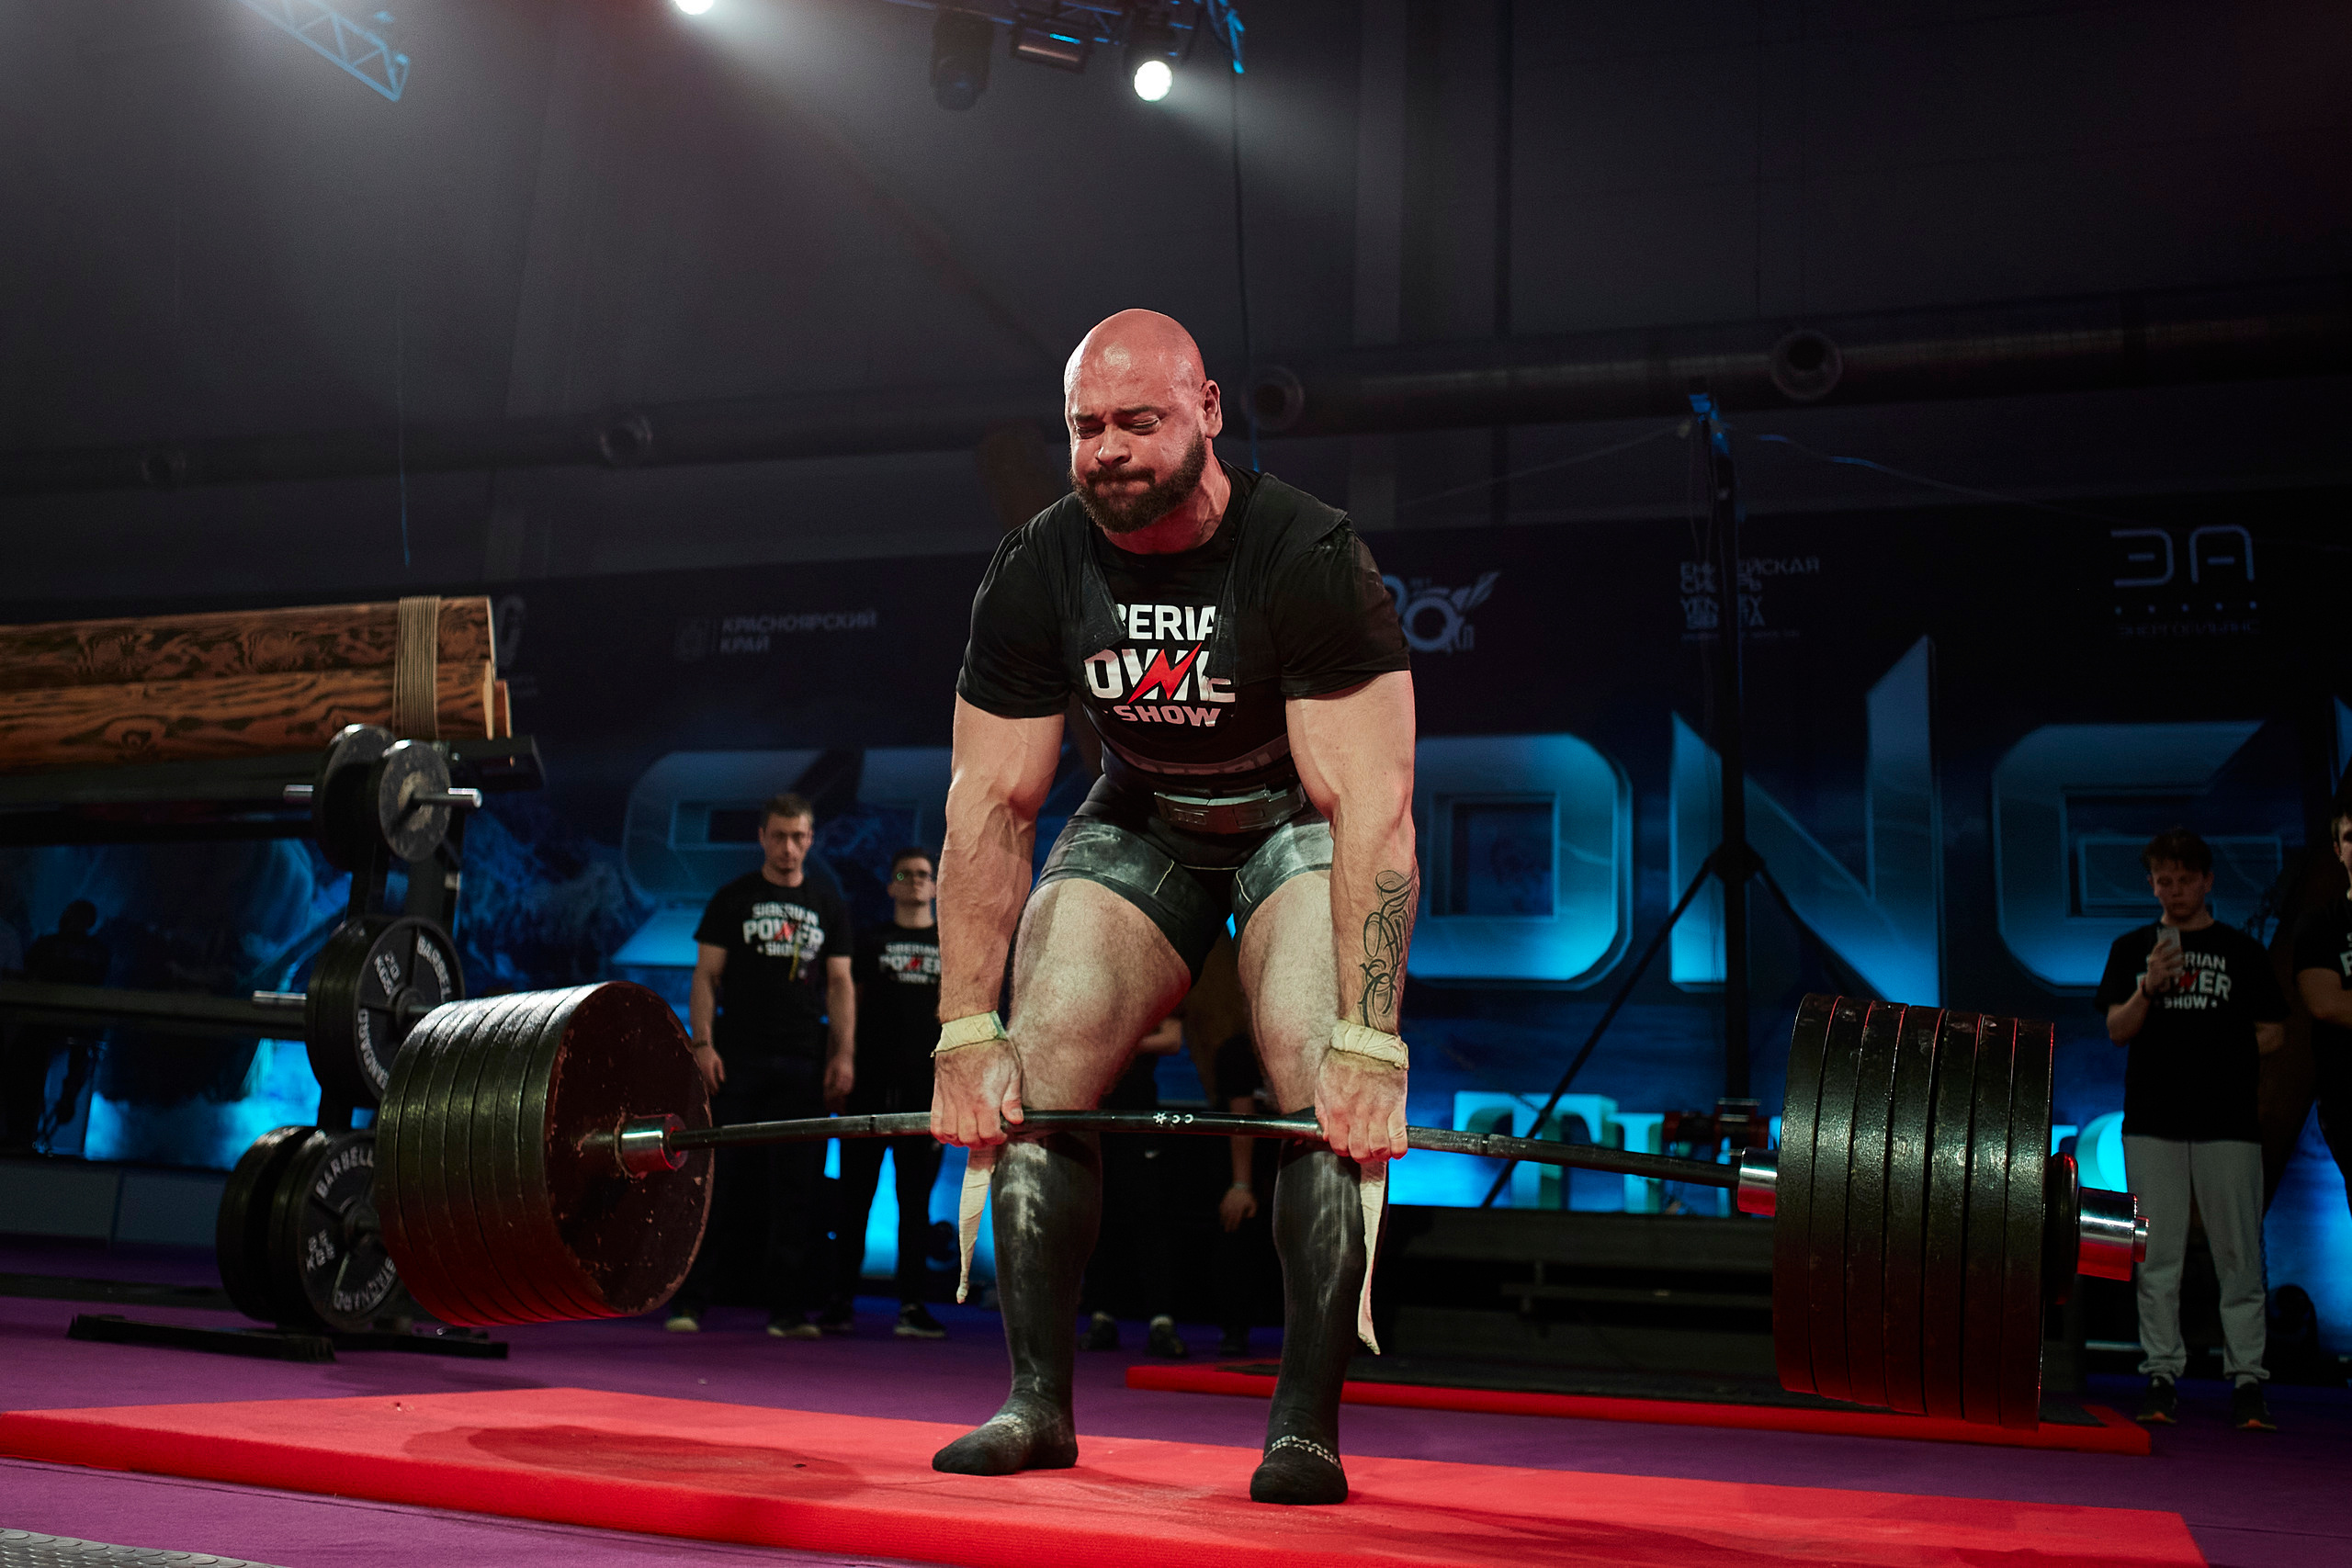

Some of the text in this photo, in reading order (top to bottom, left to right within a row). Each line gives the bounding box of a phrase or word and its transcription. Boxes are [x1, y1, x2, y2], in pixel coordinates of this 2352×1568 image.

[719, 634, 770, 653] КРАЙ
[1112, 705, 1222, 728] SHOW
[742, 918, 826, 950] POWER
[2164, 994, 2209, 1010] SHOW
[315, 1145, 375, 1200] BARBELL
